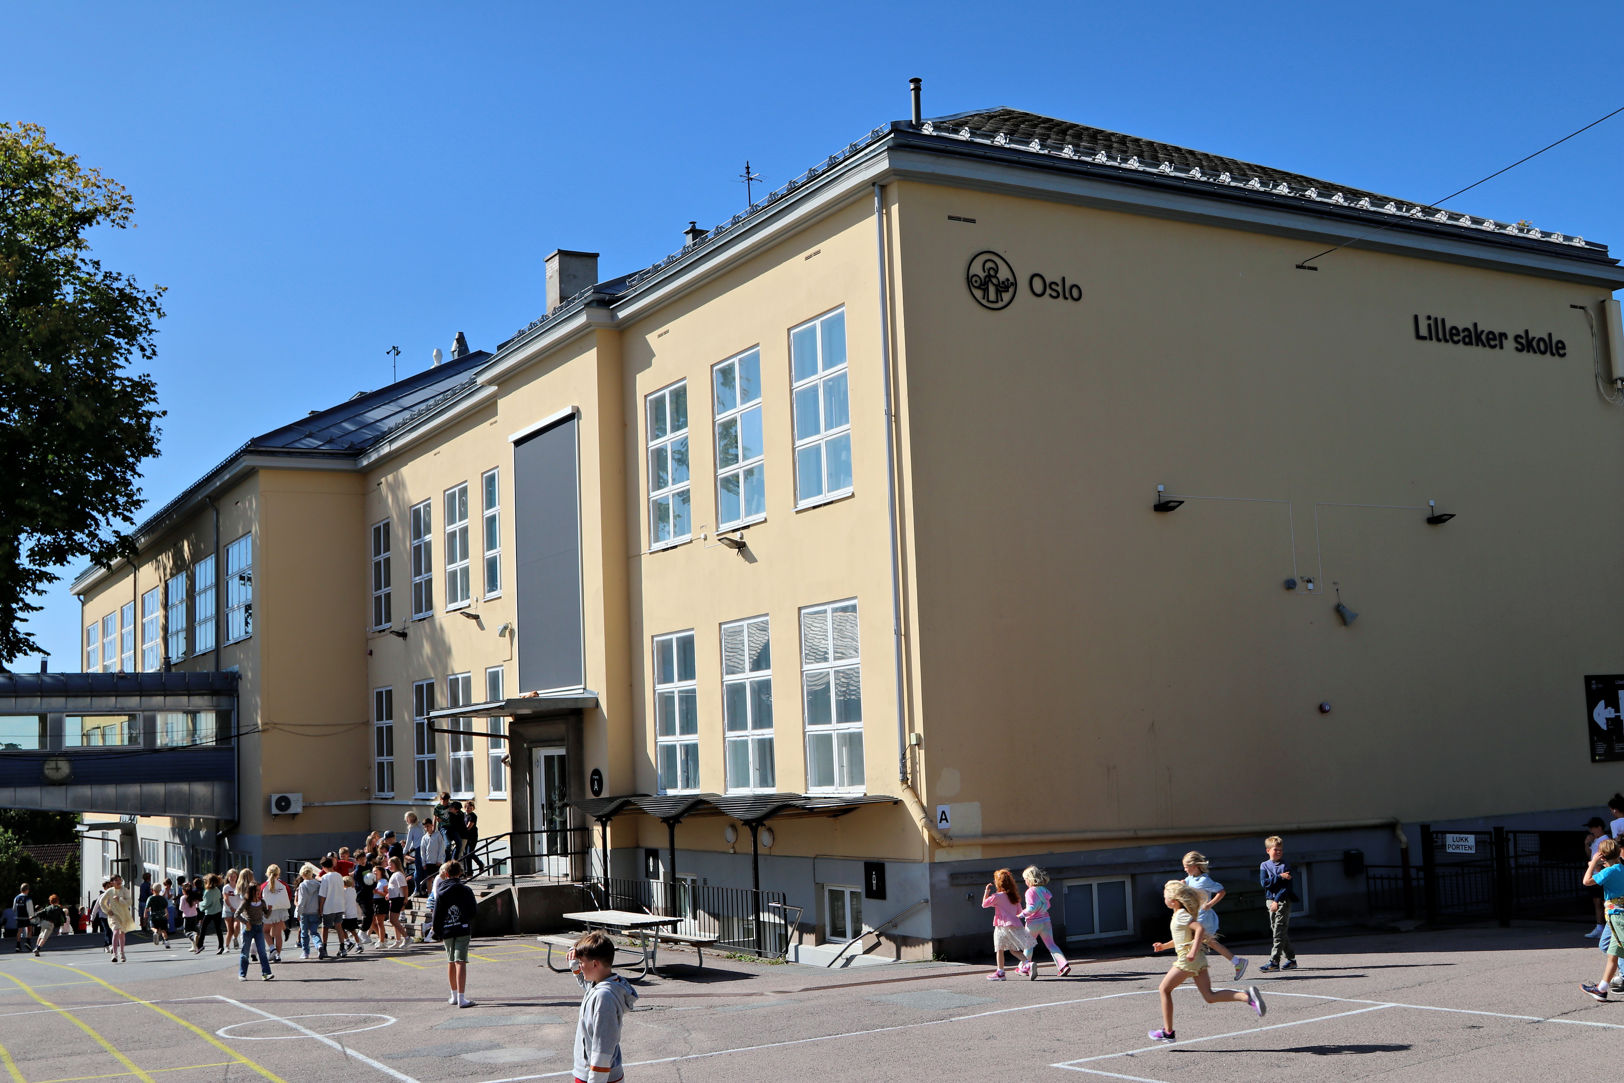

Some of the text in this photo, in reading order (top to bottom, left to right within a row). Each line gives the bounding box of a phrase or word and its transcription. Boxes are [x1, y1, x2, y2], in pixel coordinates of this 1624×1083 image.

[1029, 273, 1083, 302] Oslo
[1413, 314, 1567, 358] Lilleaker skole
[939, 810, 949, 824] A
